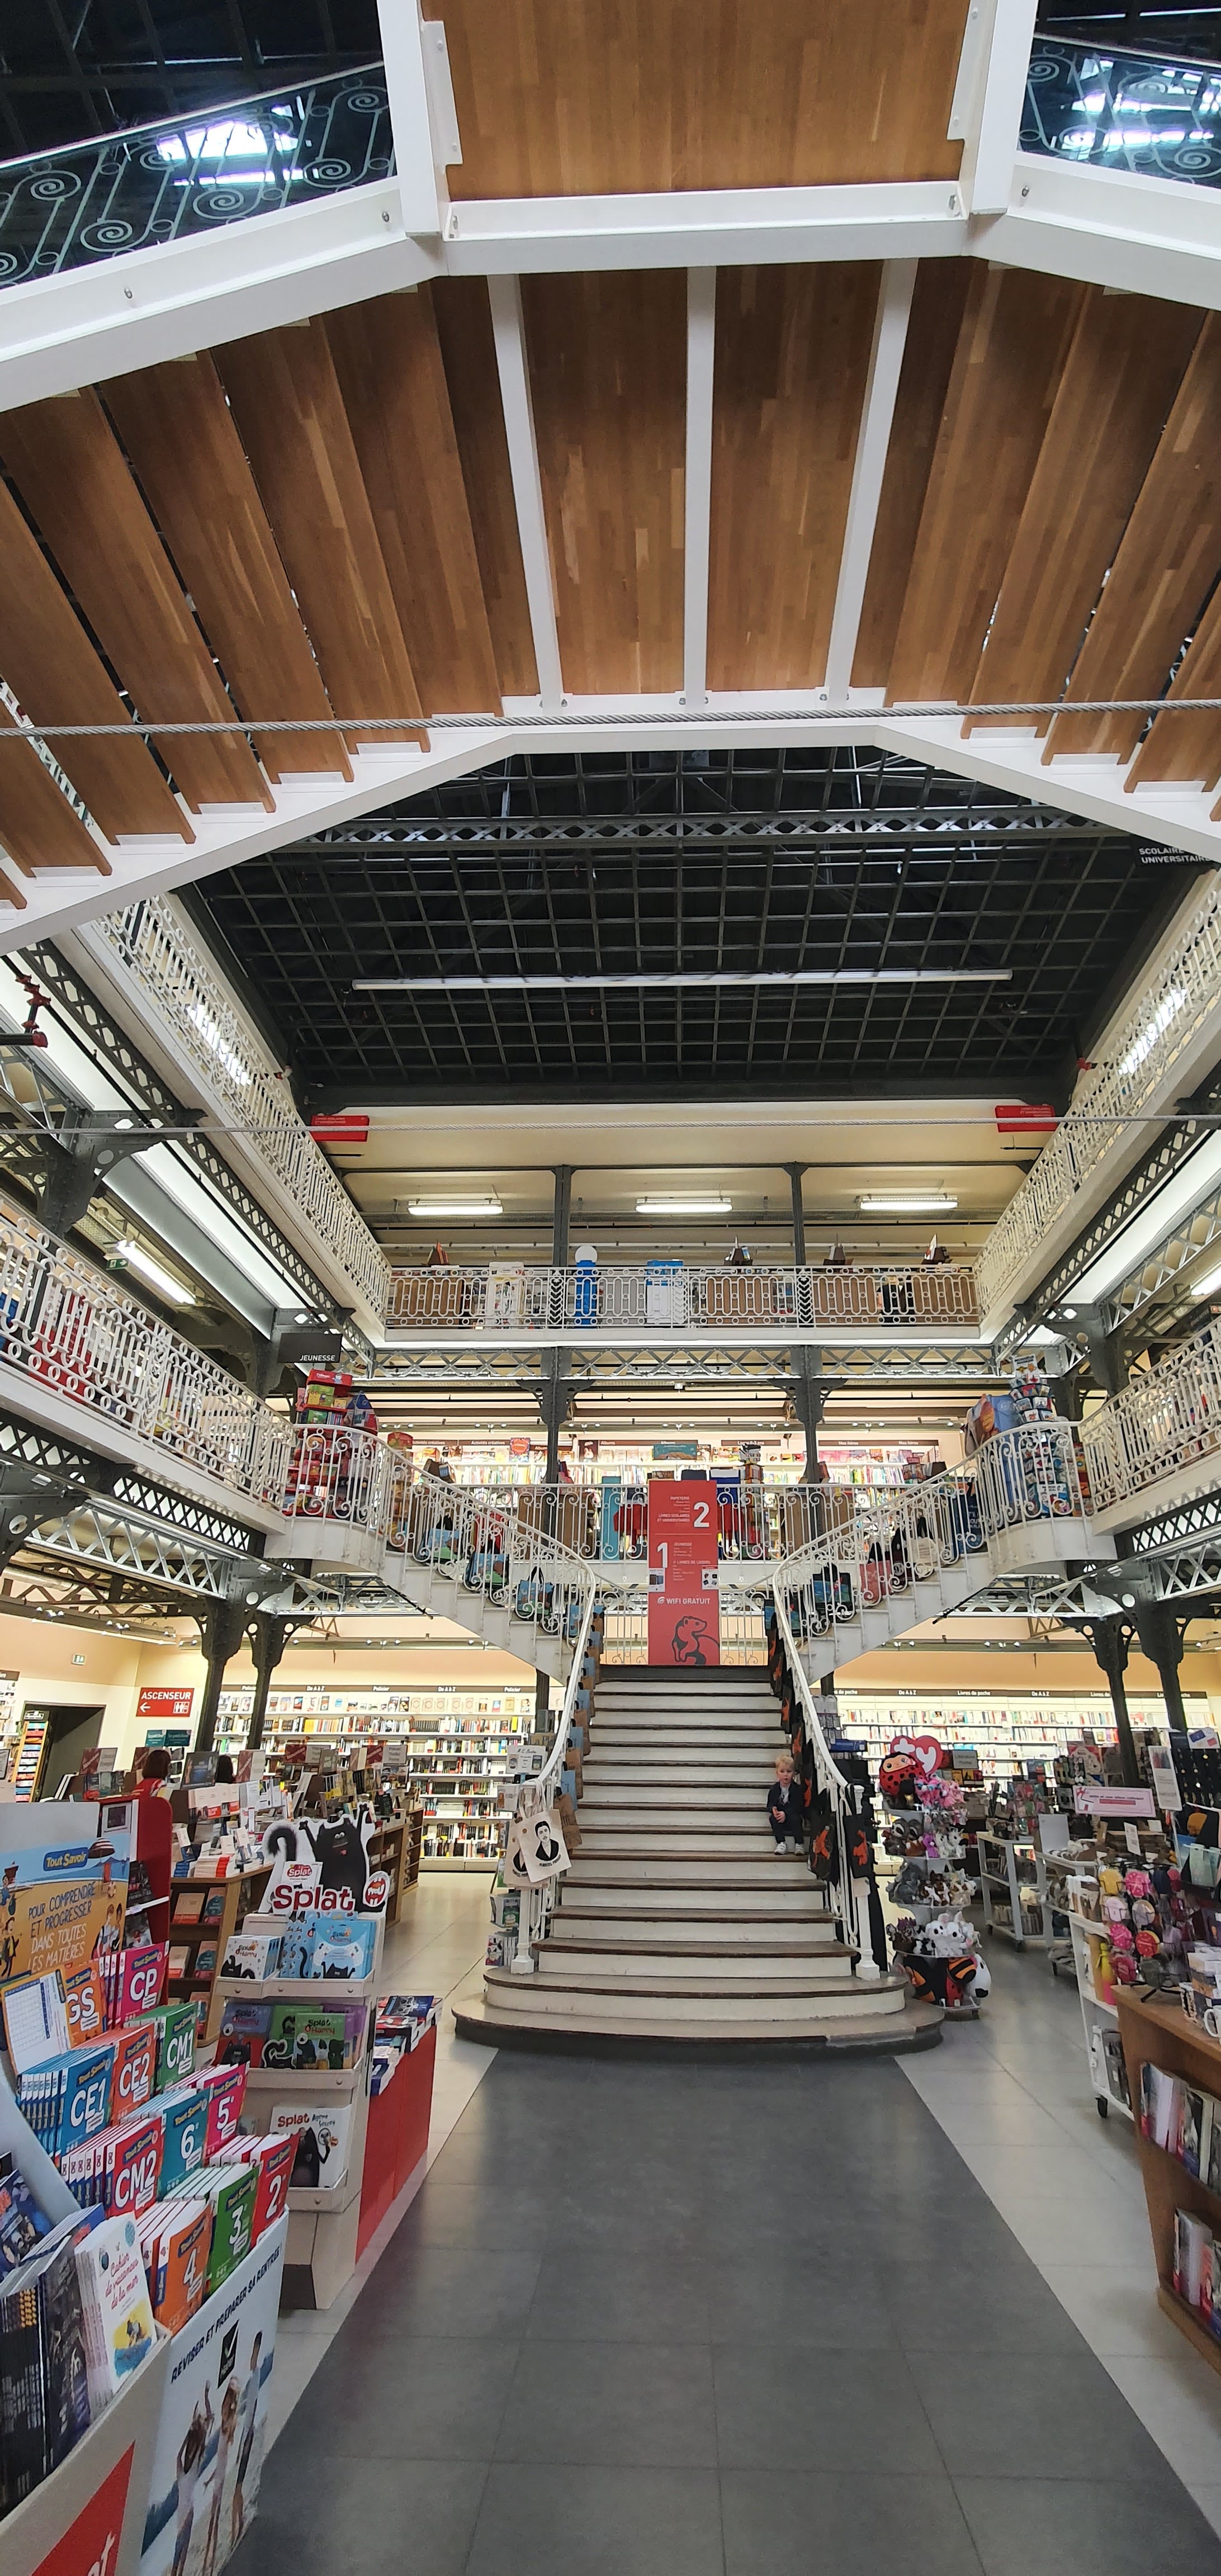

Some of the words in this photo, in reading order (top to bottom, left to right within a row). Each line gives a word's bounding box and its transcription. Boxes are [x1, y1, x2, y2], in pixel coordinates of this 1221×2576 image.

[694, 1502, 709, 1527] 2
[657, 1542, 668, 1568] 1
[141, 1691, 191, 1700] ASCENSEUR
[46, 1855, 64, 1868] Tout
[64, 1851, 87, 1867] Savoir
[288, 1867, 312, 1877] Splat
[29, 1902, 46, 1920] POUR
[49, 1881, 96, 1912] COMPRENDRE
[273, 1885, 354, 1911] Splat
[30, 1920, 42, 1938] ET
[45, 1900, 92, 1932] PROGRESSER
[31, 1931, 55, 1954] DANS
[58, 1923, 87, 1945] TOUTES
[238, 1943, 256, 1951] Splat
[29, 1955, 44, 1973] LES
[46, 1941, 86, 1968] MATIÈRES
[130, 1968, 157, 2001] CP
[67, 1986, 95, 2024] GS
[167, 2029, 193, 2068] CM1
[119, 2052, 150, 2096] CE2
[70, 2077, 106, 2127] CE1
[278, 2113, 310, 2128] Splat
[115, 2149, 157, 2208] CM2
[106, 2279, 112, 2298] de
[113, 2259, 139, 2289] vacances
[111, 2252, 130, 2277] Cahier
[111, 2292, 117, 2310] de
[119, 2285, 126, 2302] la
[126, 2275, 139, 2292] mer
[171, 2337, 205, 2384] RÉVISER
[206, 2324, 215, 2345] ET
[248, 2276, 255, 2294] SA
